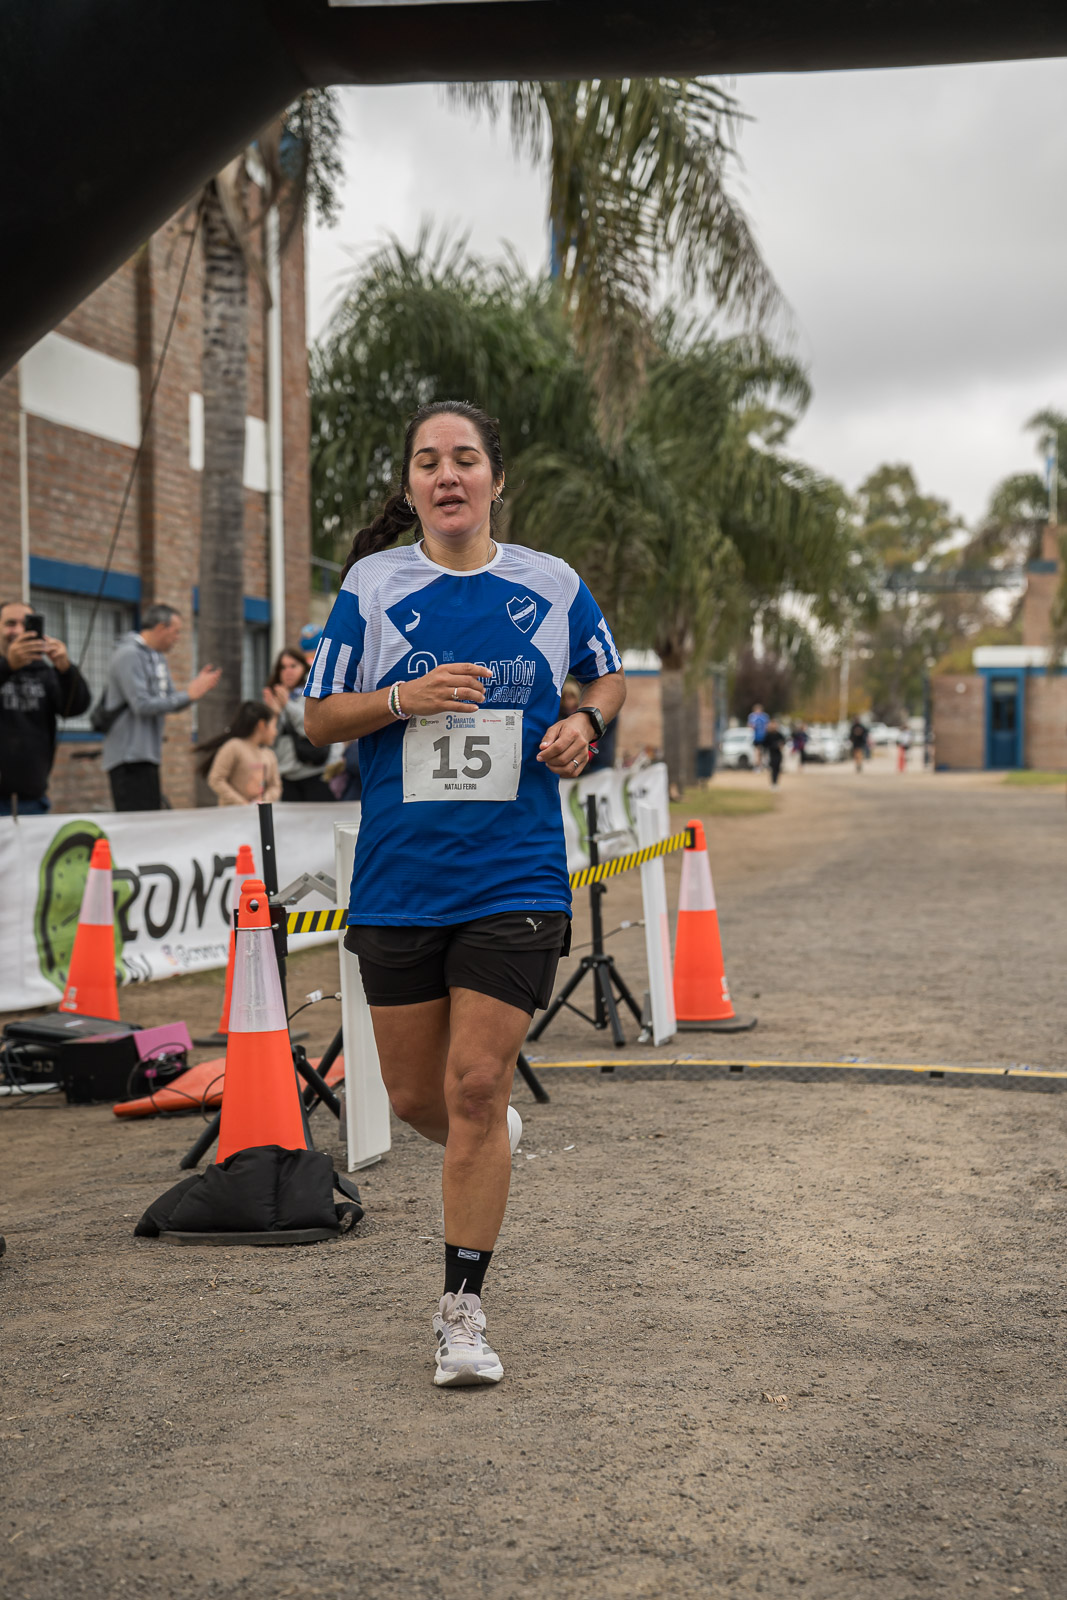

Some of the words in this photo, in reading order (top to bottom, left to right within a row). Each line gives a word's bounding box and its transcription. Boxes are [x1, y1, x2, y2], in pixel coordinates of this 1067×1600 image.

[473, 655, 536, 687] RATÓN
[445, 714, 453, 731] 3
[432, 735, 492, 779] 15
[444, 783, 462, 791] NATALI
[463, 783, 477, 791] FERRI
